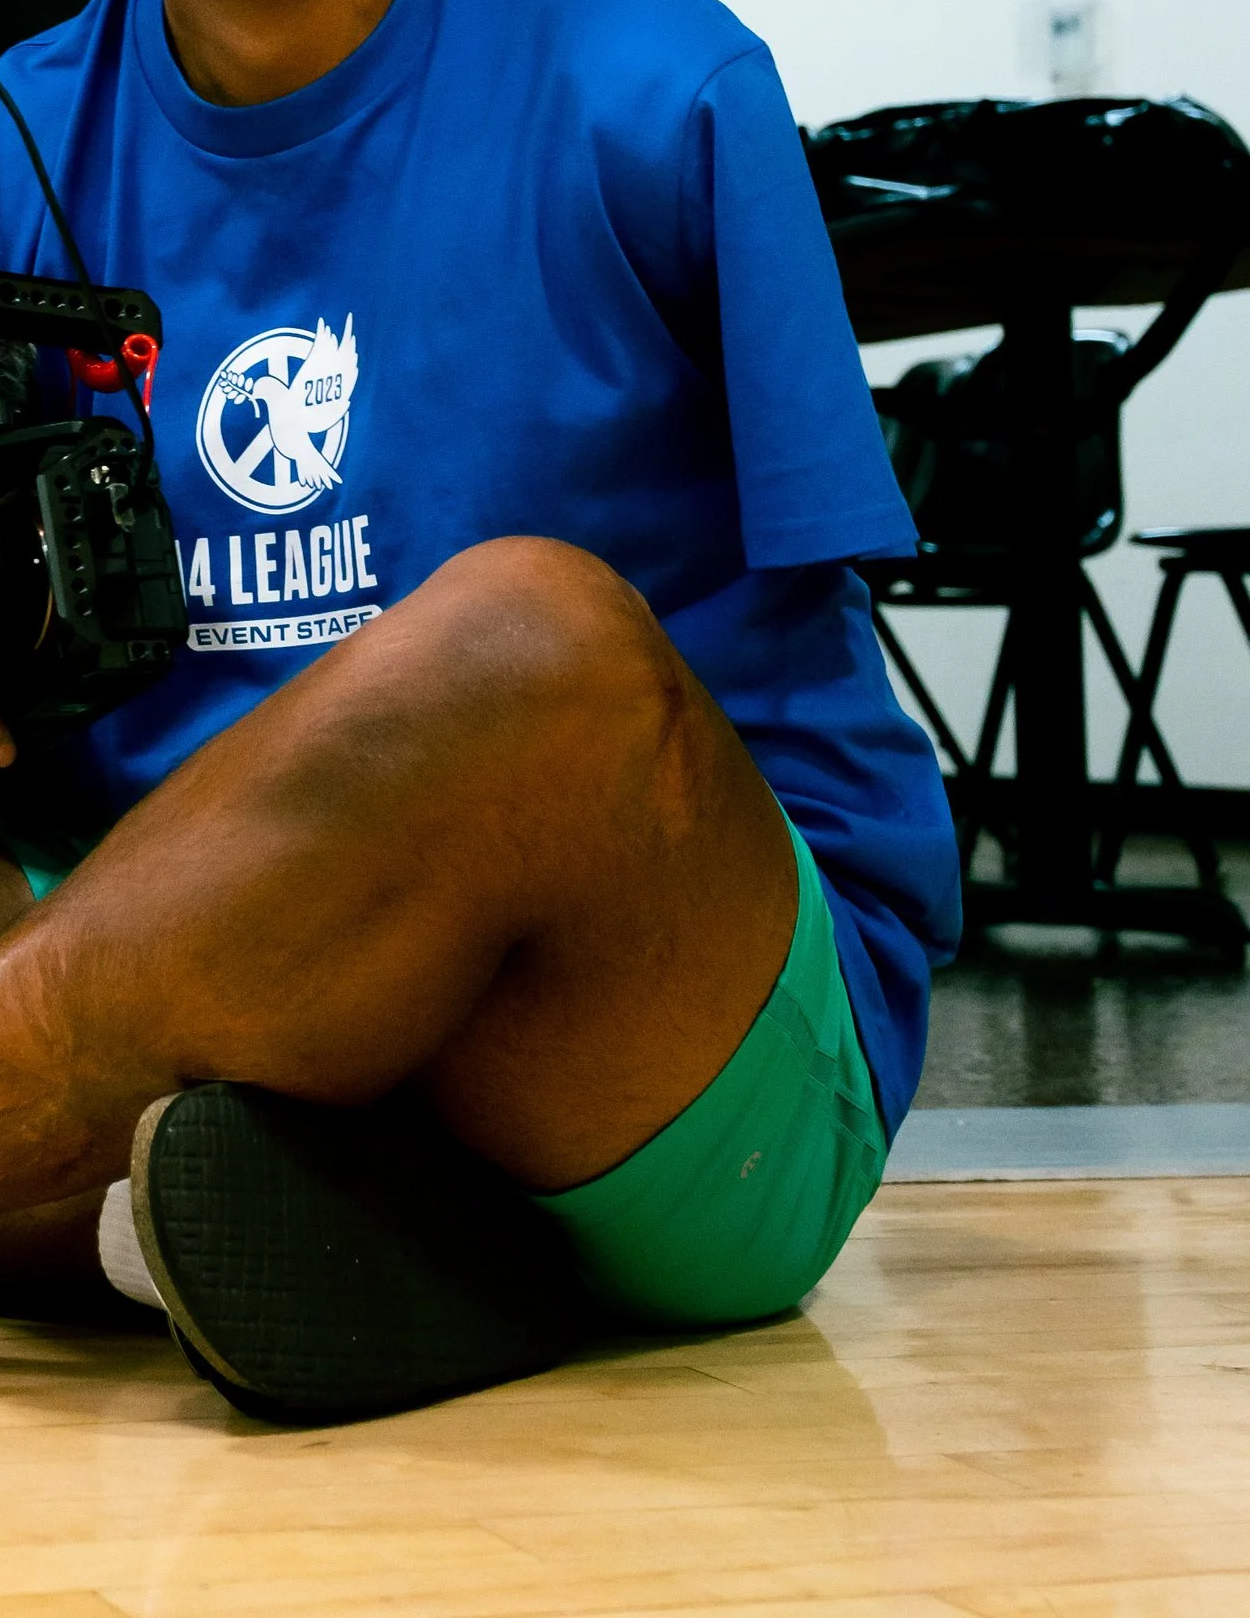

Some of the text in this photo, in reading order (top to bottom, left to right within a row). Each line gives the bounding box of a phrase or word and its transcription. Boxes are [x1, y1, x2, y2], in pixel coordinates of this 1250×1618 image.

[305, 374, 342, 406] 2023
[174, 515, 377, 607] 4 LEAGUE
[196, 611, 372, 646] EVENT STAFF
